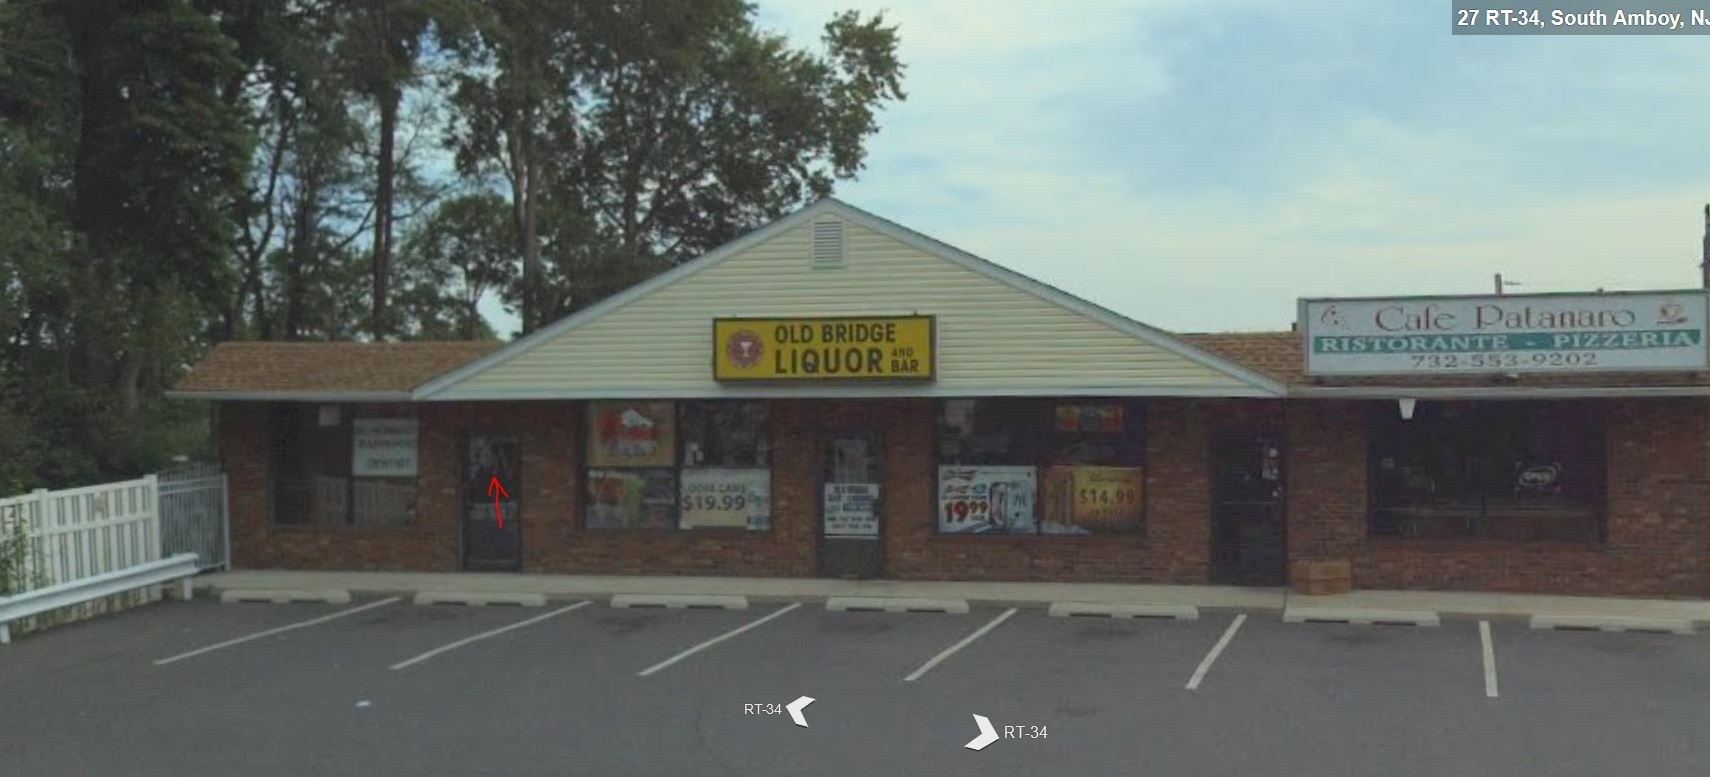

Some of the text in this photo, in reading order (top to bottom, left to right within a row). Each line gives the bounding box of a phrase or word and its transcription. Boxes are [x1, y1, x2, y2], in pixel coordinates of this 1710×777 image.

[1375, 305, 1636, 332] Cafe Patanaro
[774, 323, 896, 344] OLD BRIDGE
[1321, 335, 1508, 353] RISTORANTE
[1554, 331, 1693, 350] PIZZERIA
[774, 347, 884, 374] LIQUOR
[892, 347, 914, 358] AND
[1411, 353, 1599, 369] 732-553-9202
[890, 359, 919, 373] BAR
[680, 494, 746, 512] $19.99
[1080, 488, 1135, 505] $14.99
